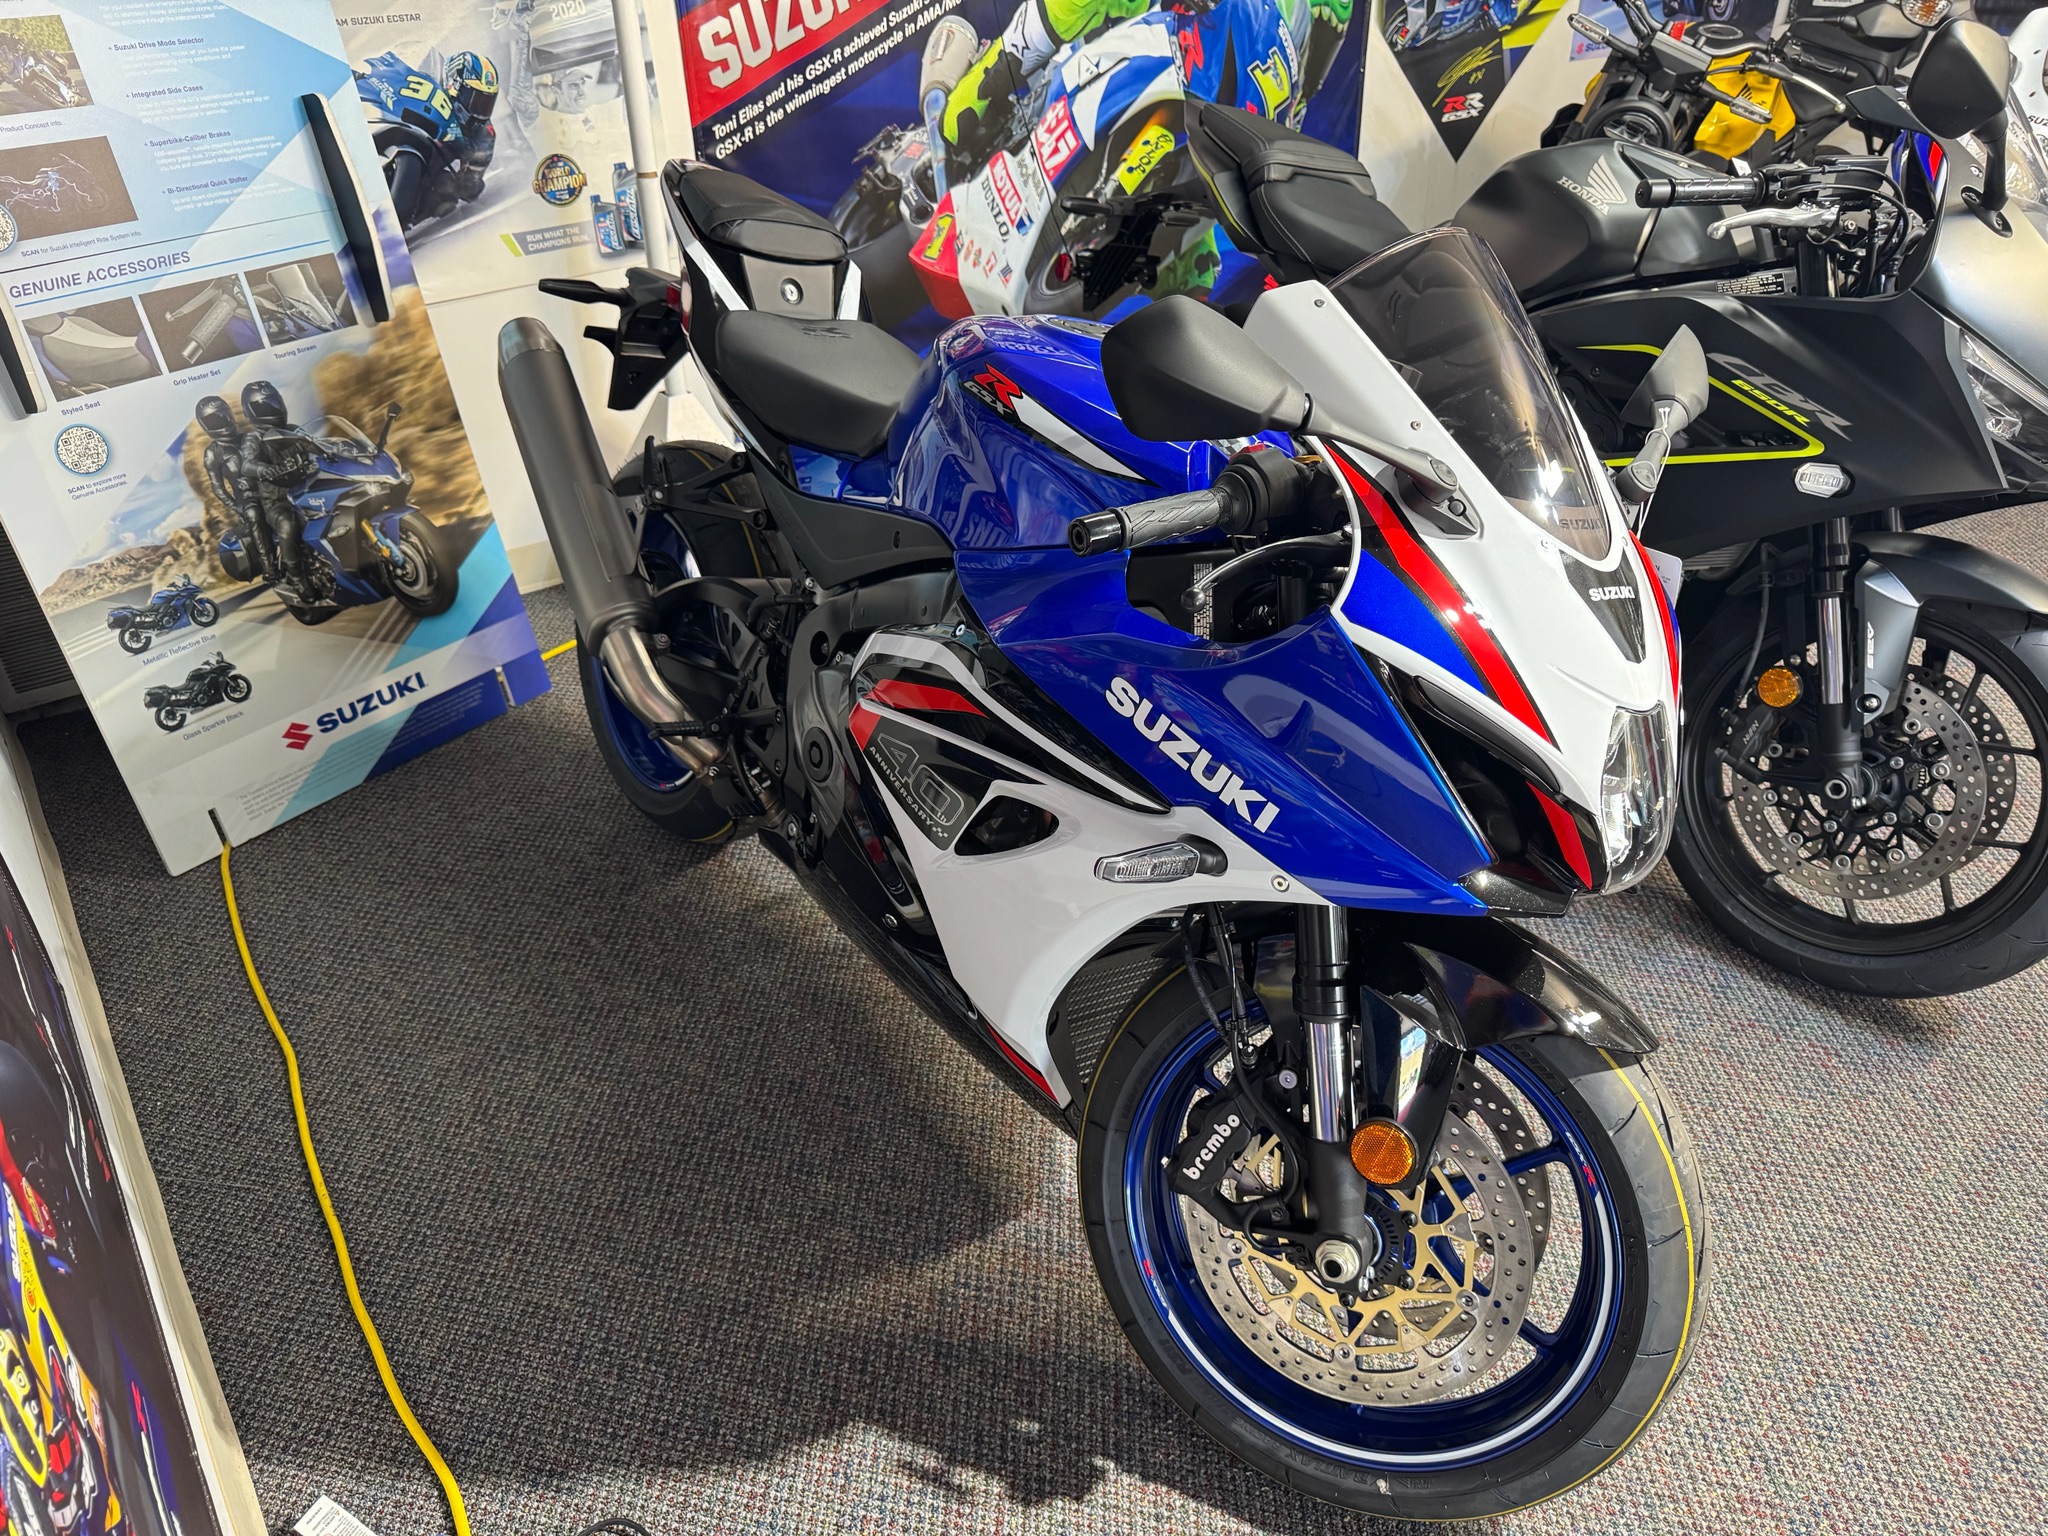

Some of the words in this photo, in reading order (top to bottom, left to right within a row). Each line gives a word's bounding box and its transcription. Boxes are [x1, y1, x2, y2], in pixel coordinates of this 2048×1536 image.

[350, 15, 385, 27] SUZUKI
[386, 12, 421, 25] ECSTAR
[113, 44, 138, 52] Suzuki
[138, 41, 157, 50] Drive
[157, 39, 177, 48] Mode
[177, 37, 205, 46] Selector
[712, 117, 738, 140] Toni
[738, 100, 766, 123] Elias
[765, 84, 786, 107] and
[786, 72, 805, 93] his
[804, 47, 844, 80] GSX-R
[843, 21, 889, 58] achieved
[714, 131, 755, 160] GSX-R
[754, 118, 766, 136] is
[765, 104, 785, 128] the
[784, 68, 847, 115] winningest
[847, 32, 904, 77] motorcycle
[904, 22, 916, 38] in
[131, 88, 166, 99] Integrated
[166, 86, 183, 96] Side
[182, 85, 204, 94] Cases
[399, 74, 454, 121] 36
[0, 125, 24, 133] Product
[25, 122, 50, 131] Concept
[149, 133, 208, 148] Superbike-Caliber
[208, 130, 231, 139] Brakes
[544, 165, 571, 179] WORLD
[167, 182, 209, 195] Bi-Directional
[209, 179, 229, 188] Quick
[228, 176, 249, 185] Shifter
[992, 154, 1022, 222] MOTUL
[1557, 176, 1611, 216] HONDA
[21, 248, 40, 257] SCAN
[49, 243, 69, 252] Suzuki
[69, 239, 96, 250] Intelligent
[110, 233, 131, 242] System
[526, 232, 543, 242] RUN
[543, 229, 566, 240] WHAT
[565, 227, 581, 237] THE
[528, 237, 572, 251] CHAMPIONS
[9, 272, 83, 299] GENUINE
[86, 251, 191, 284] ACCESSORIES
[274, 350, 297, 360] Touring
[297, 344, 318, 354] Screen
[173, 378, 188, 387] Grip
[188, 372, 210, 383] Heater
[210, 368, 222, 377] Set
[61, 405, 84, 416] Styled
[84, 401, 101, 410] Seat
[964, 381, 1013, 416] GSX
[1731, 379, 1811, 427] 650R
[67, 485, 86, 495] SCAN
[92, 476, 113, 488] explore
[71, 490, 95, 501] Genuine
[95, 480, 129, 494] Accessories.
[1588, 586, 1636, 601] SUZUKI
[142, 652, 169, 666] Metallic
[169, 641, 201, 657] Reflective
[201, 633, 217, 644] Blue
[316, 672, 426, 734] SUZUKI
[182, 729, 202, 742] Glass
[201, 718, 227, 734] Sparkle
[226, 711, 245, 722] Black
[1105, 676, 1280, 833] SUZUKI
[869, 746, 934, 826] ANNIVERSARY
[1182, 1114, 1240, 1180] brembo
